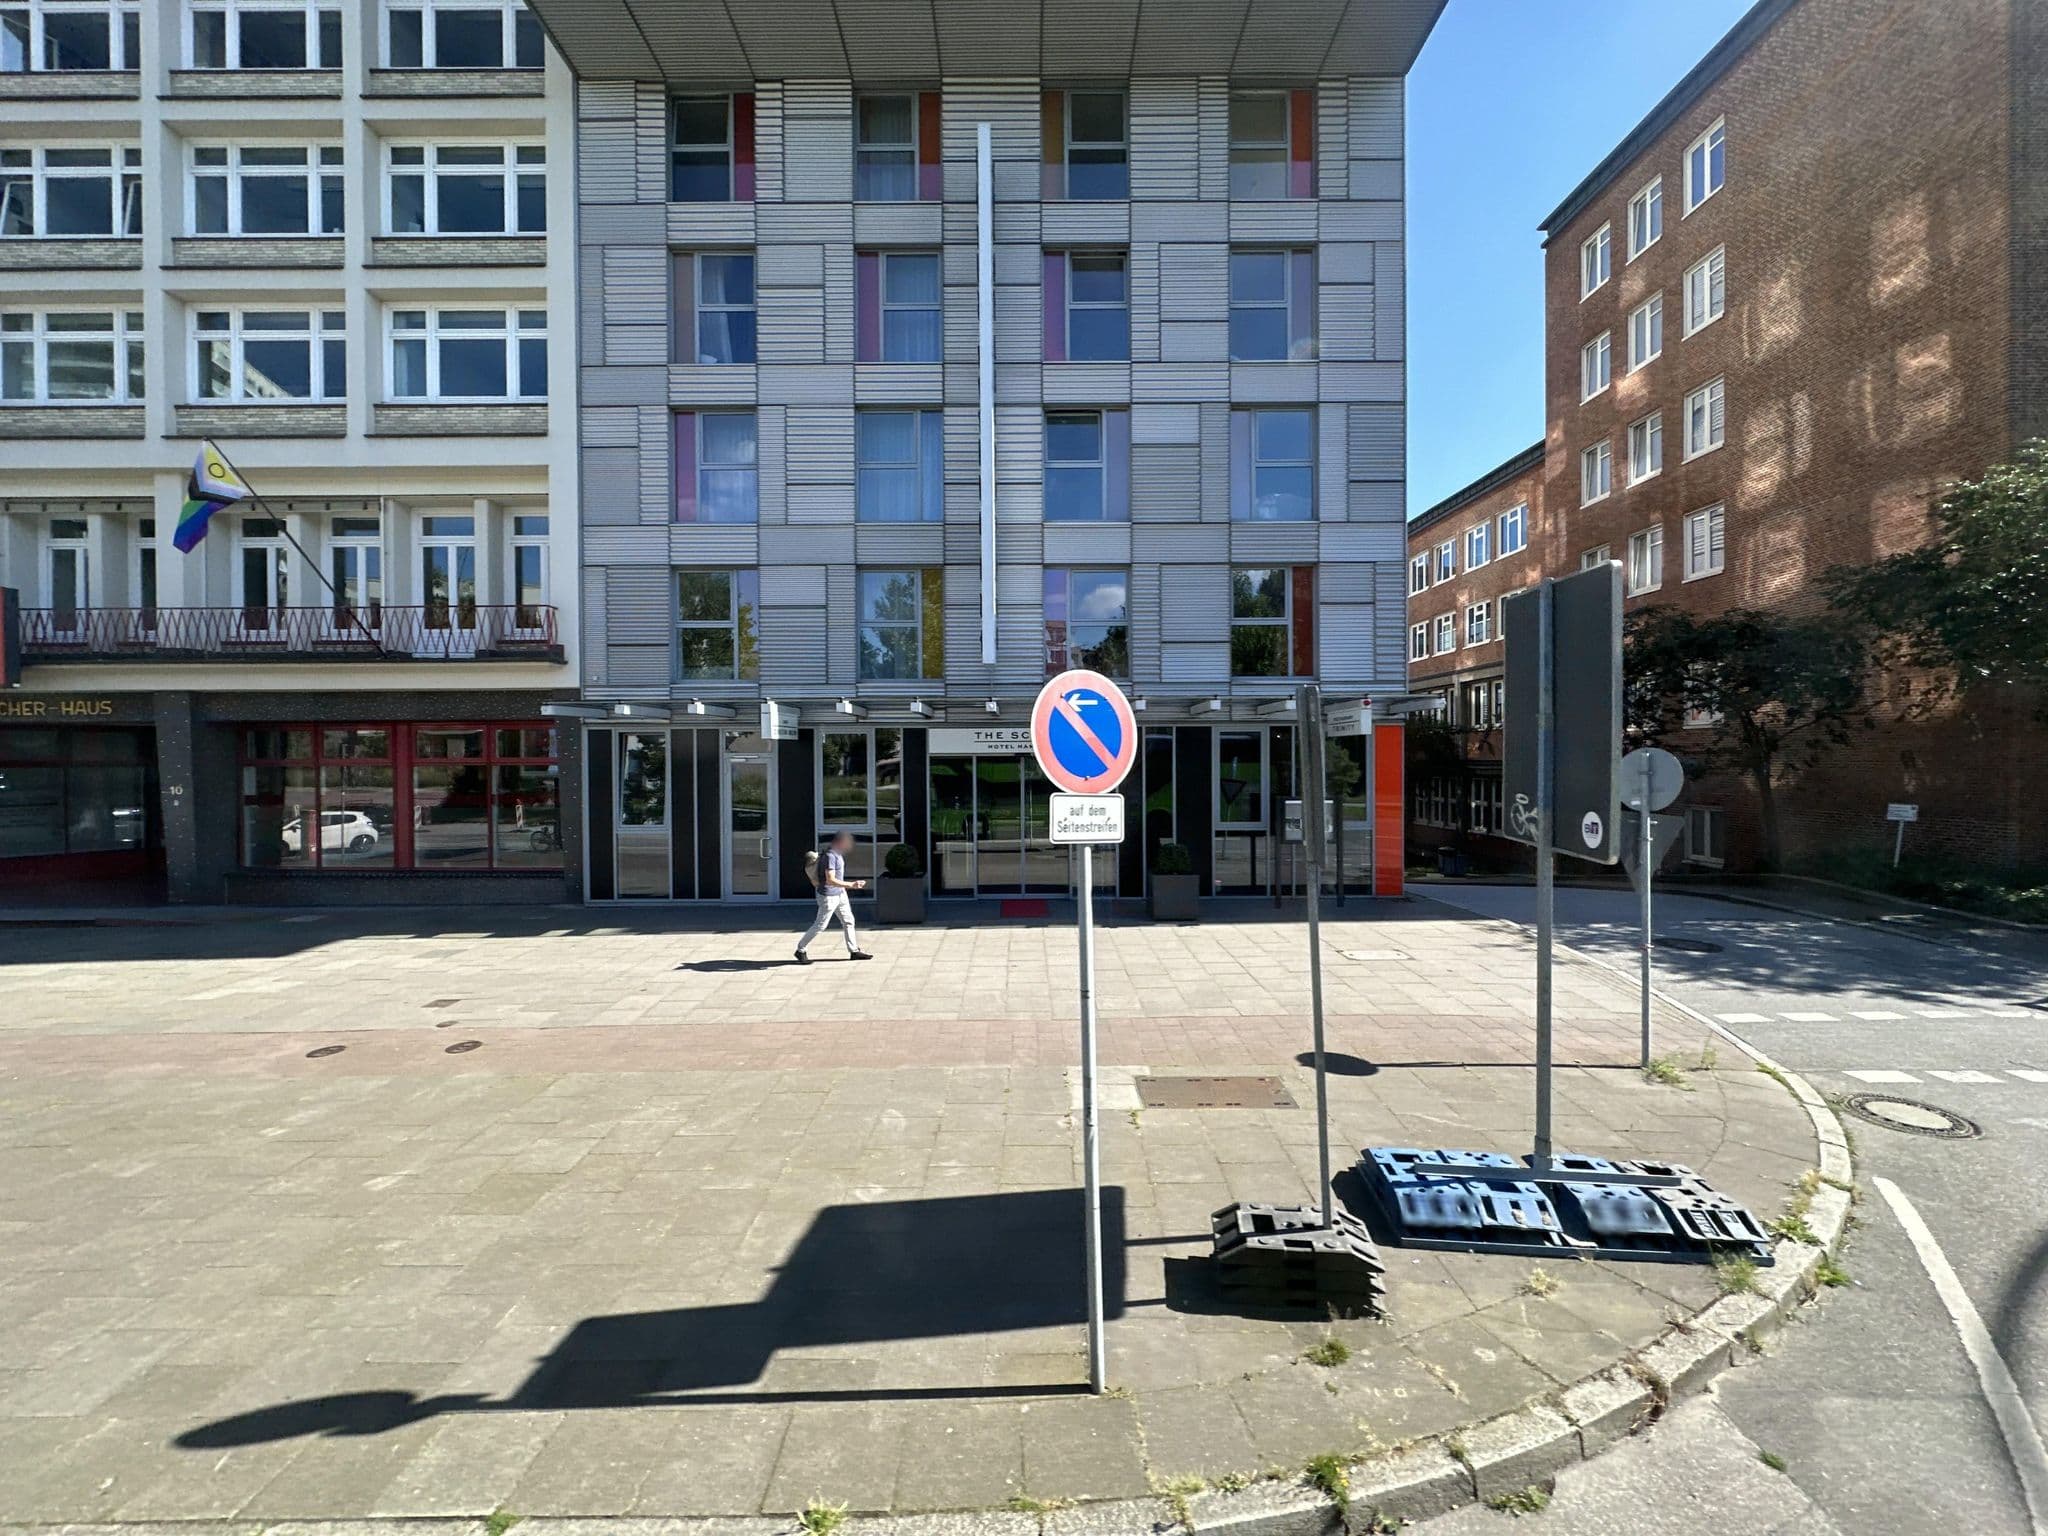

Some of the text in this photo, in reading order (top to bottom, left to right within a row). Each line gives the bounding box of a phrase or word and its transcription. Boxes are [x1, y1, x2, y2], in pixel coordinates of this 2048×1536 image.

[974, 731, 1031, 740] THE SC
[170, 786, 184, 796] 10
[1069, 803, 1107, 817] auf dem
[1056, 818, 1119, 834] Seitenstreifen
